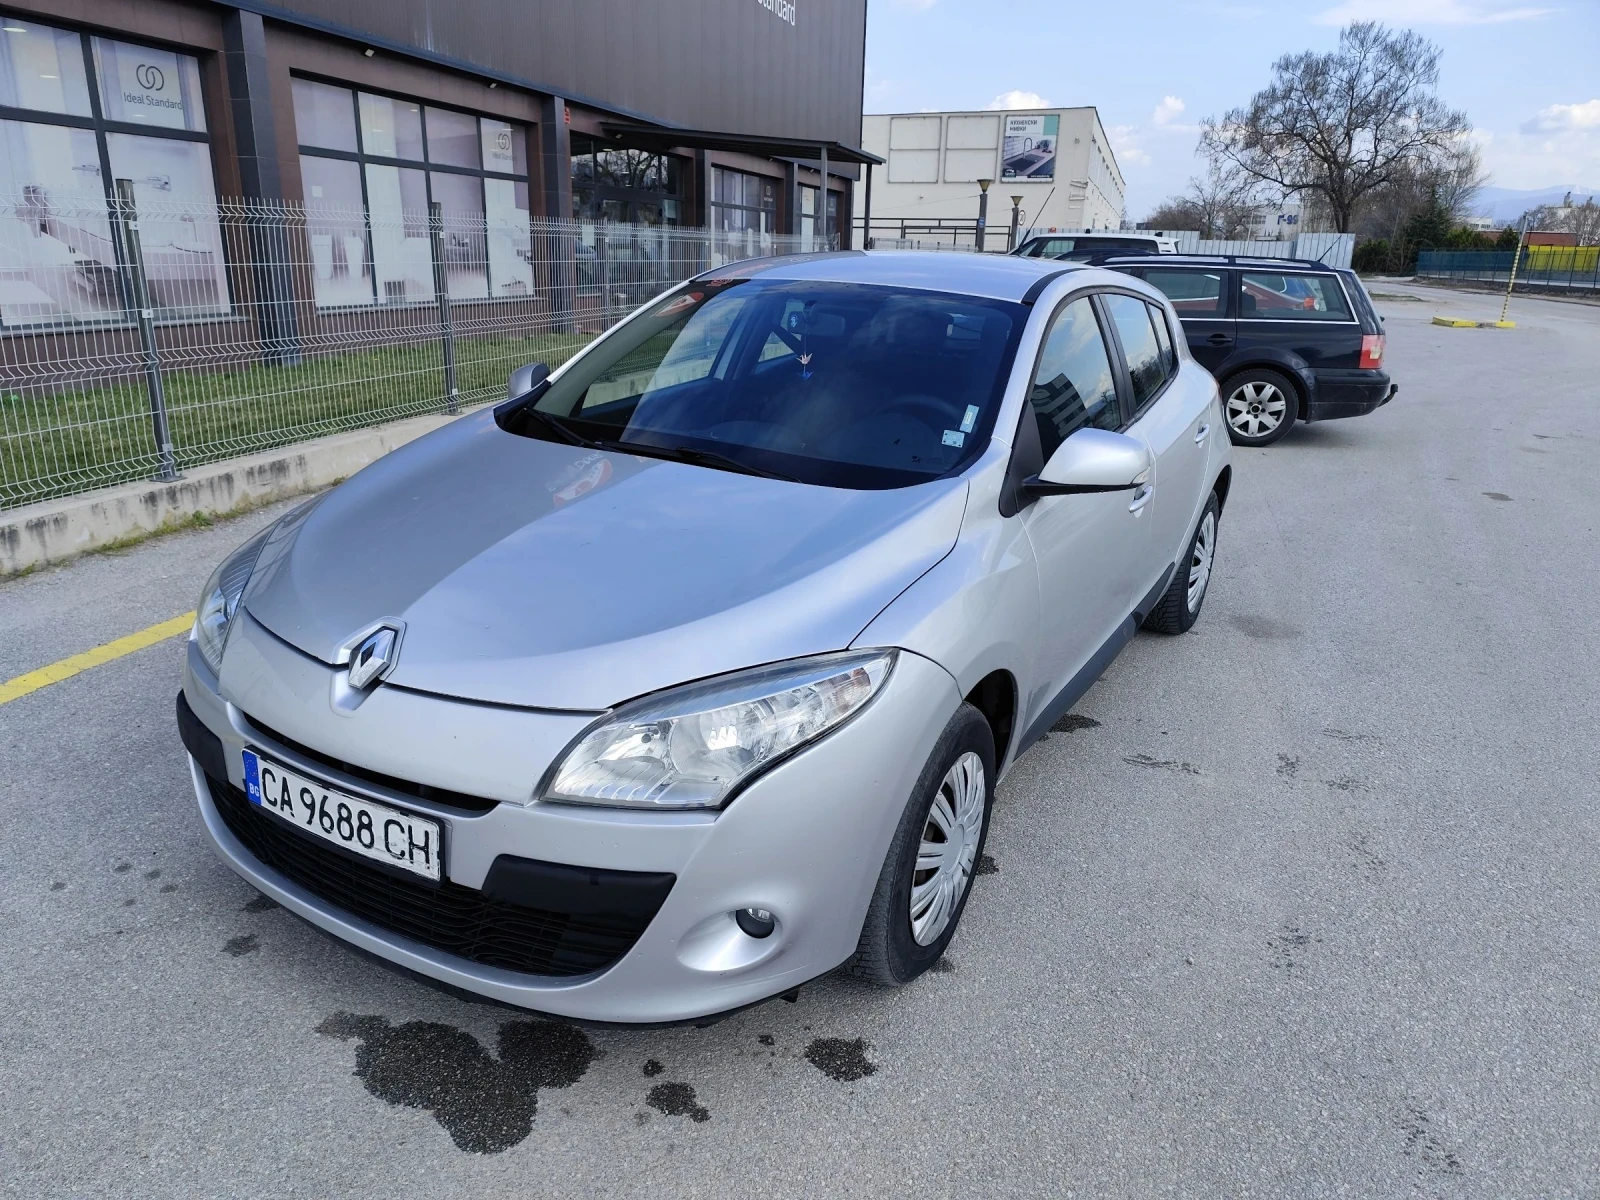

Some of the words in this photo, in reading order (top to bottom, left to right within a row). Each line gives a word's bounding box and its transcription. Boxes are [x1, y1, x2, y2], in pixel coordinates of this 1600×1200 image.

[757, 0, 795, 26] andard
[123, 92, 145, 104] Ideal
[145, 95, 183, 110] Standard
[248, 782, 261, 798] BG
[261, 767, 295, 818] CA
[299, 786, 375, 850] 9688
[383, 818, 430, 870] CH
